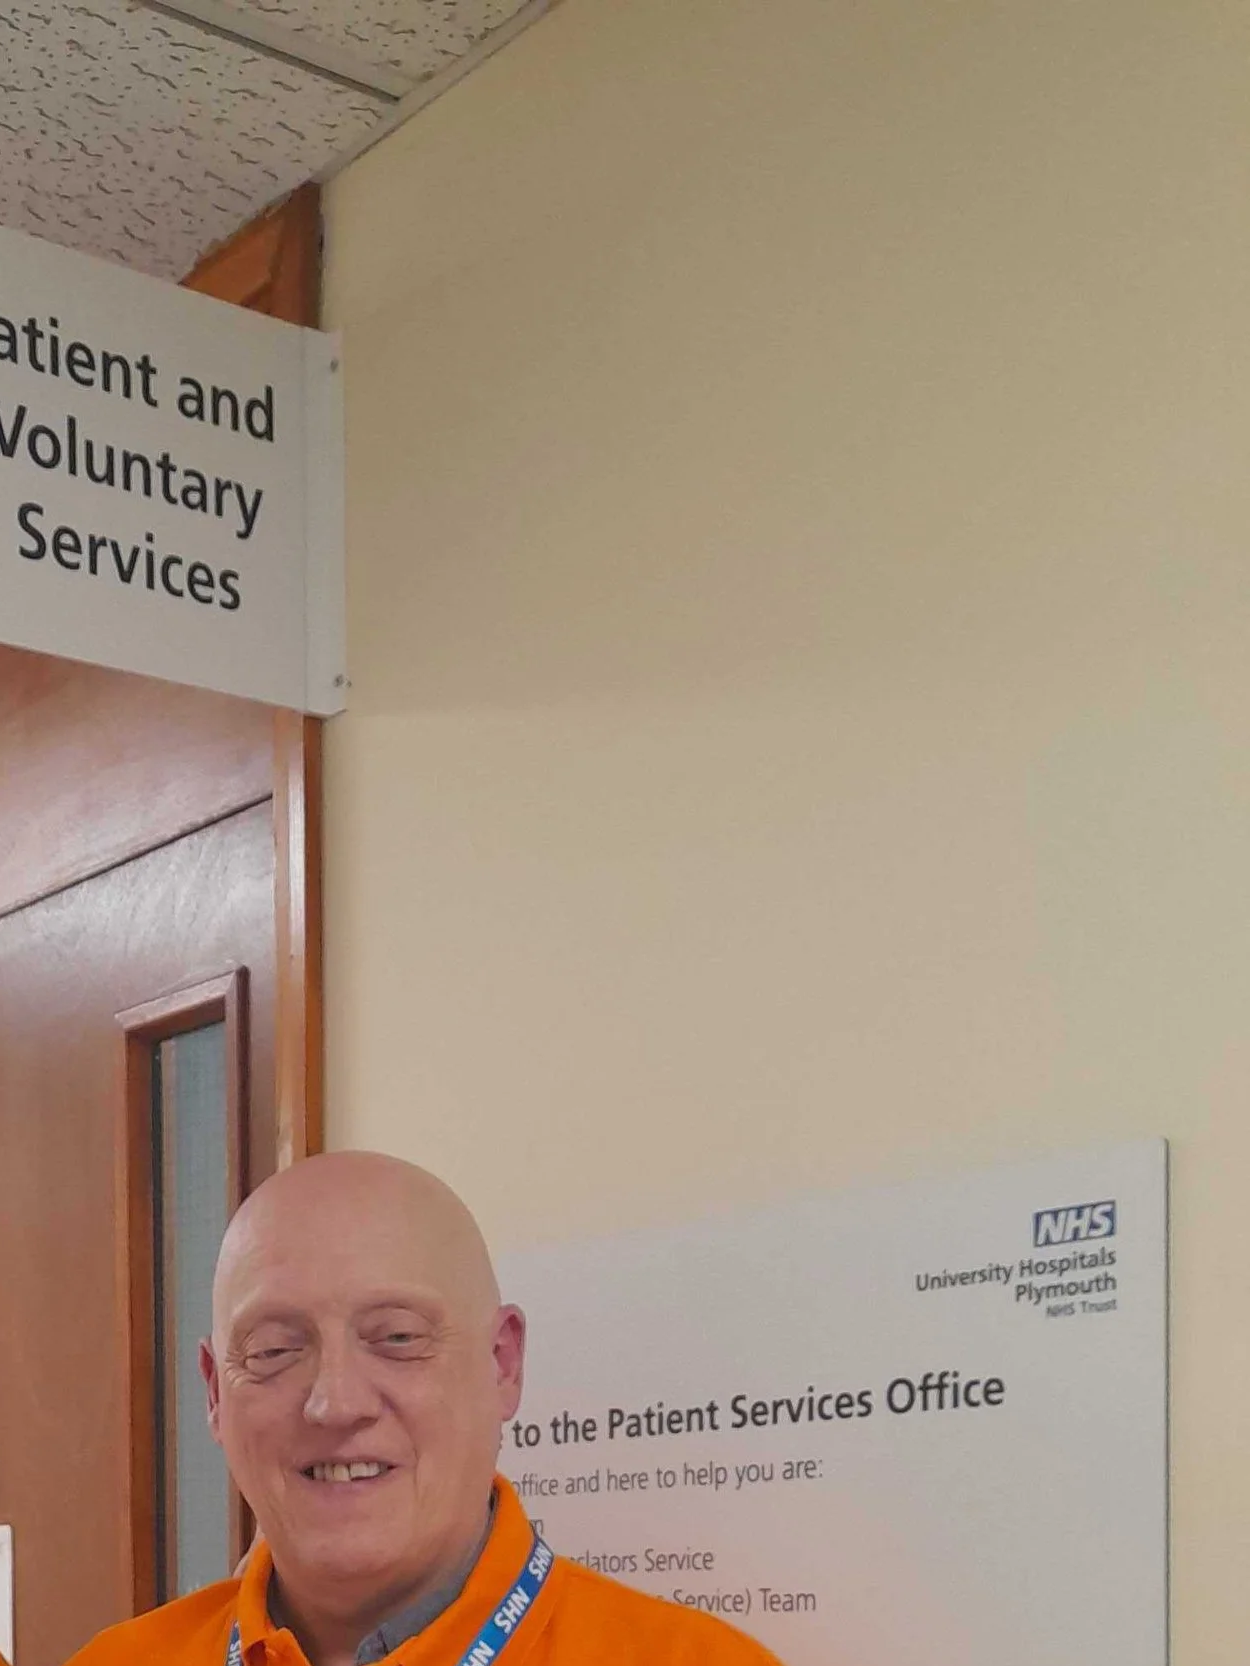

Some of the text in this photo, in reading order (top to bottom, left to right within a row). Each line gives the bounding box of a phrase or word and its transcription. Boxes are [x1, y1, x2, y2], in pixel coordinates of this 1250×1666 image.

[177, 376, 274, 442] and
[17, 502, 241, 611] Services
[1037, 1202, 1114, 1246] NHS
[916, 1247, 1117, 1292] University Hospitals
[1015, 1271, 1117, 1305] Plymouth
[1046, 1299, 1117, 1317] NHS Trust
[512, 1370, 1006, 1448] to the Patient Services Office
[511, 1458, 824, 1497] office and here to help you are:
[644, 1546, 715, 1573] Service
[493, 1585, 530, 1633] NHS
[759, 1587, 817, 1613] Team
